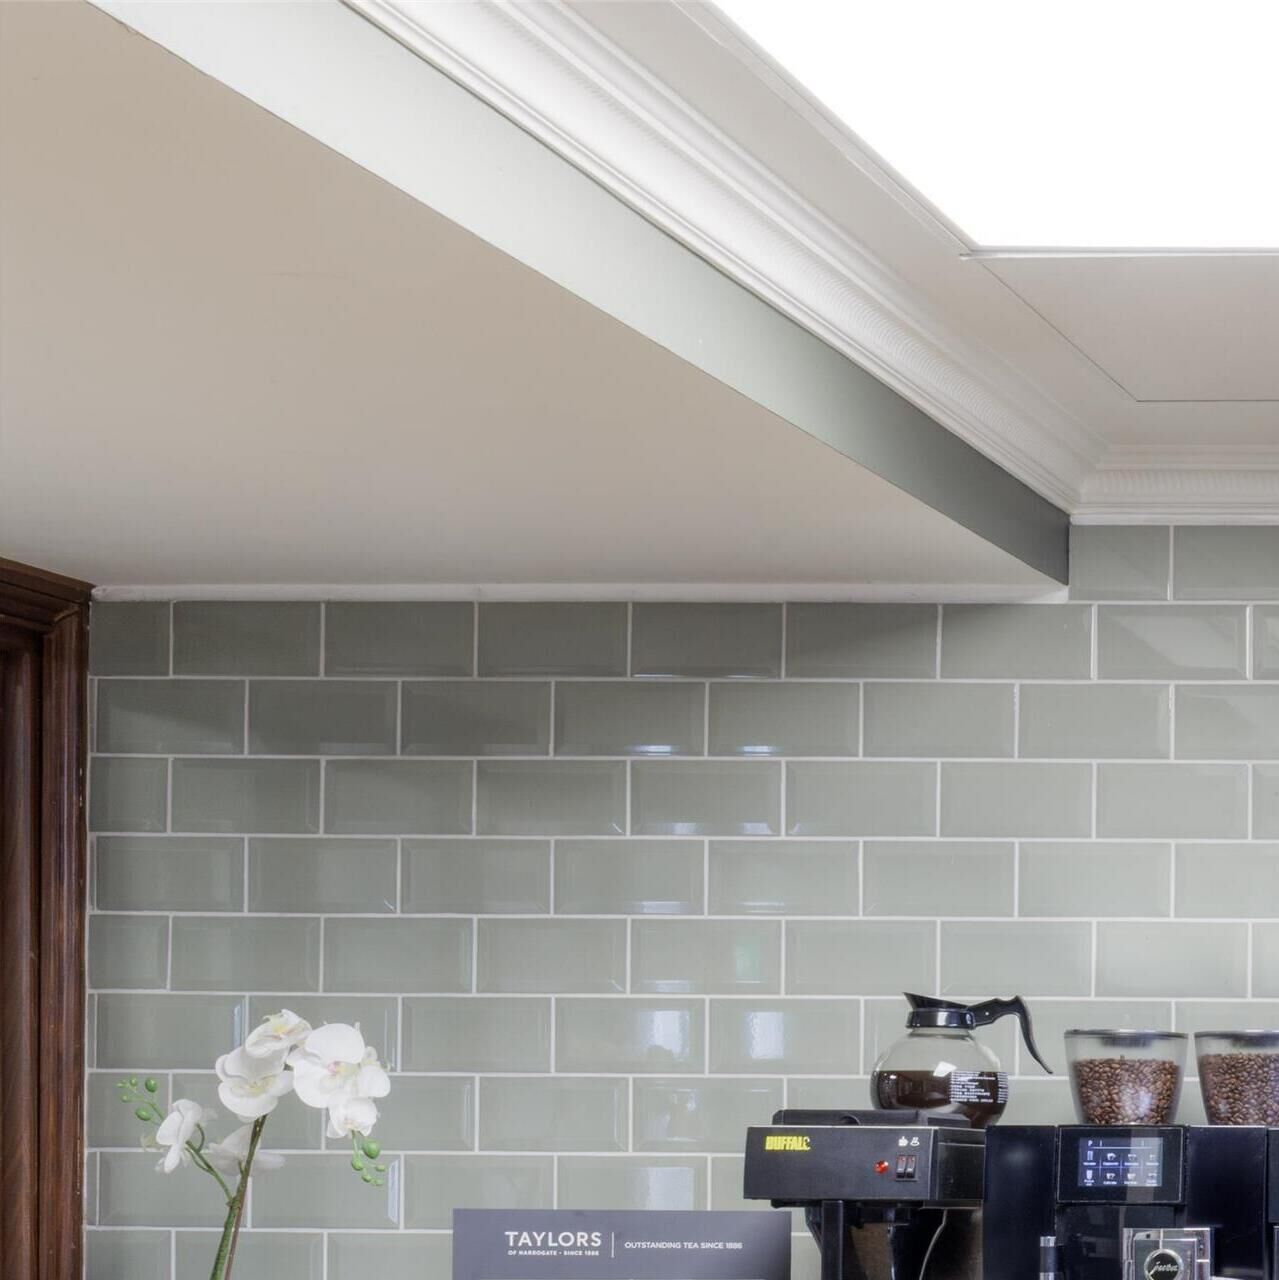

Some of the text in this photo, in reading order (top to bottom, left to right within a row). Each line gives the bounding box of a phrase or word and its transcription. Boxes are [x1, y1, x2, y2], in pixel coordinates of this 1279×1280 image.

[504, 1231, 602, 1247] TAYLORS
[624, 1241, 682, 1250] OUTSTANDING
[683, 1241, 699, 1249] TEA
[700, 1241, 724, 1249] SINCE
